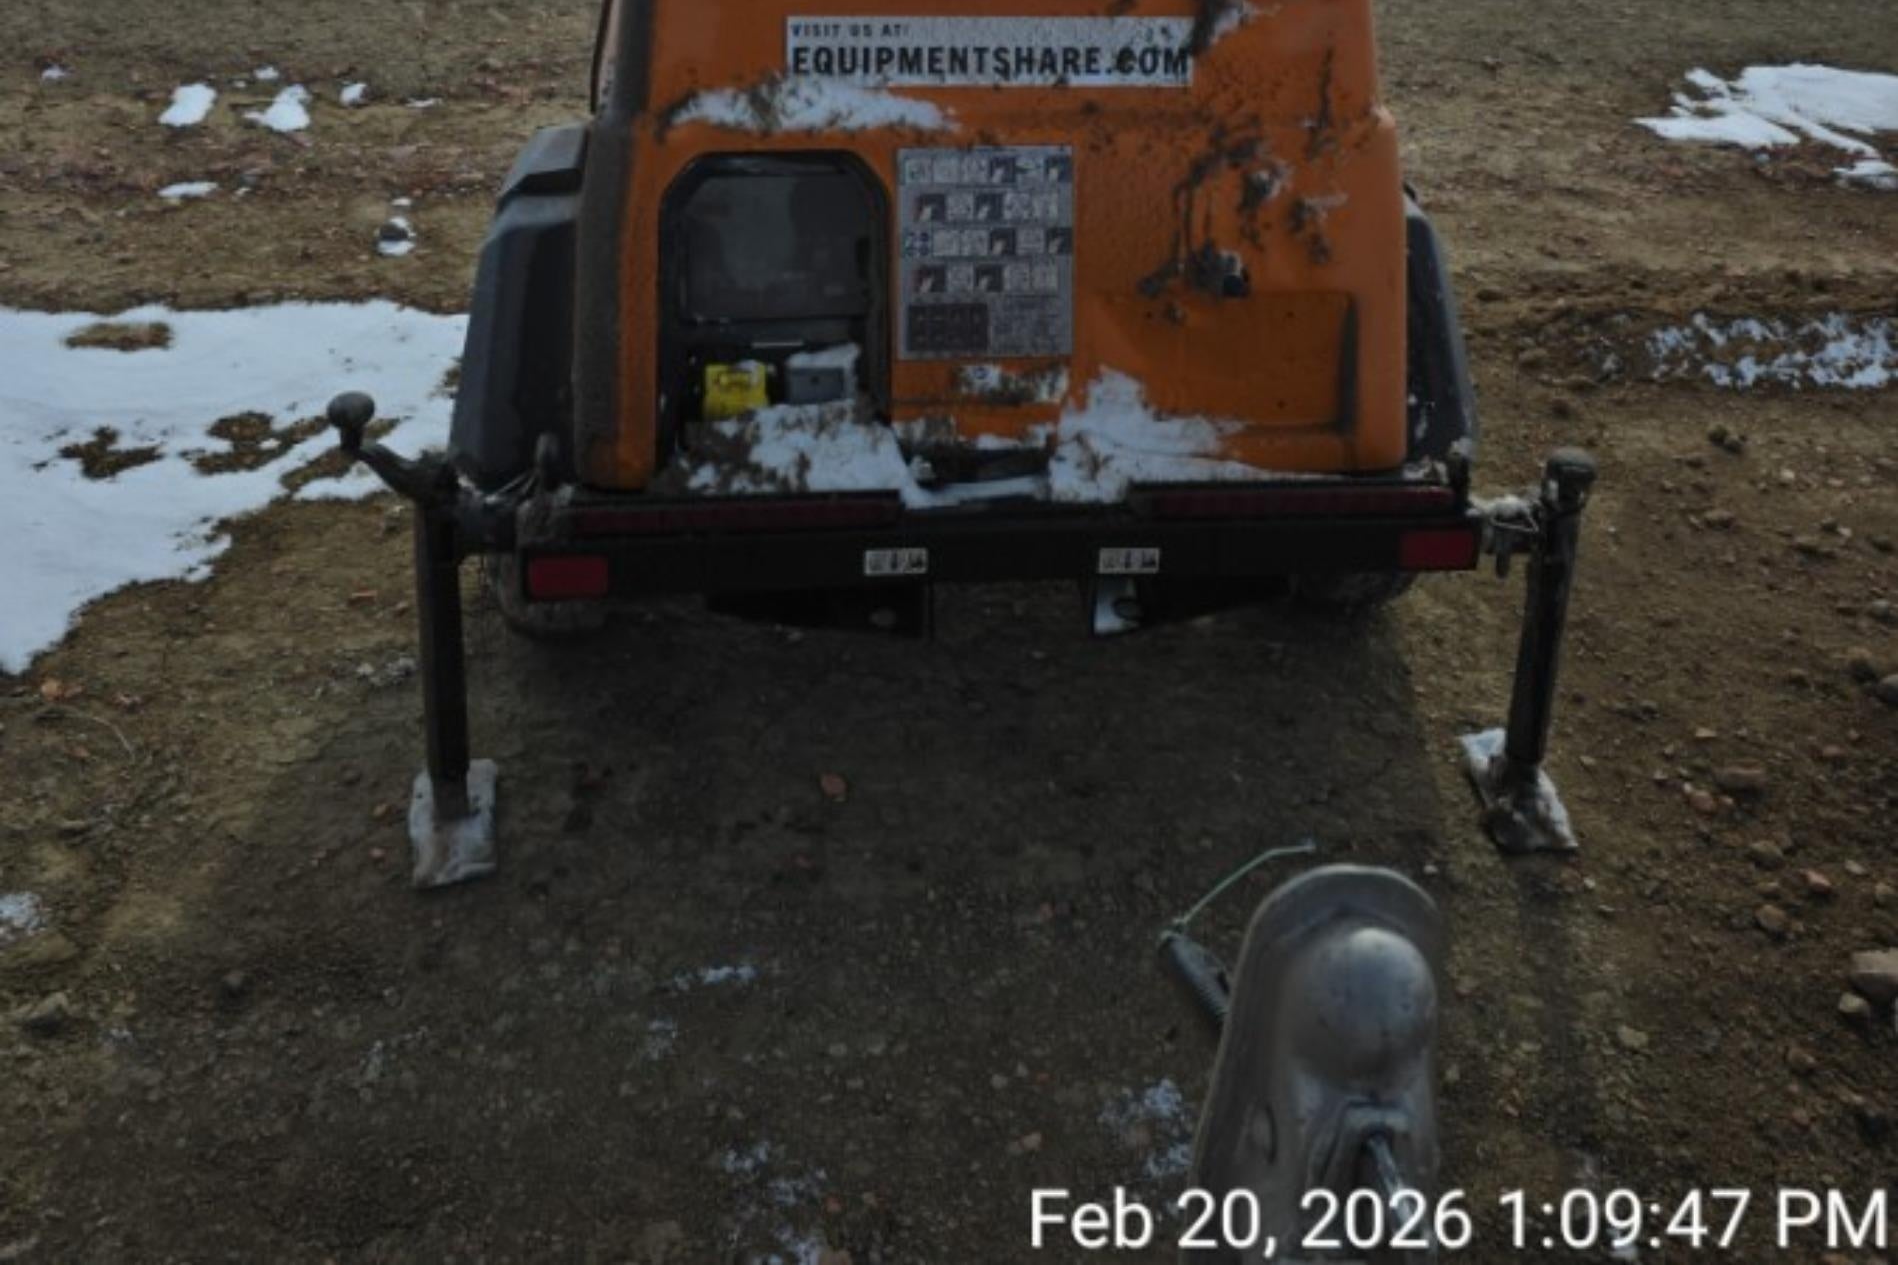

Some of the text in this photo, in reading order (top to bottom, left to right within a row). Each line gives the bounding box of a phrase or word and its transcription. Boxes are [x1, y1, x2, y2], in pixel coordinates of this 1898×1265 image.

[792, 24, 841, 37] VISIT
[851, 24, 873, 37] US
[793, 46, 1189, 77] EQUIPMENTSHARE.COM
